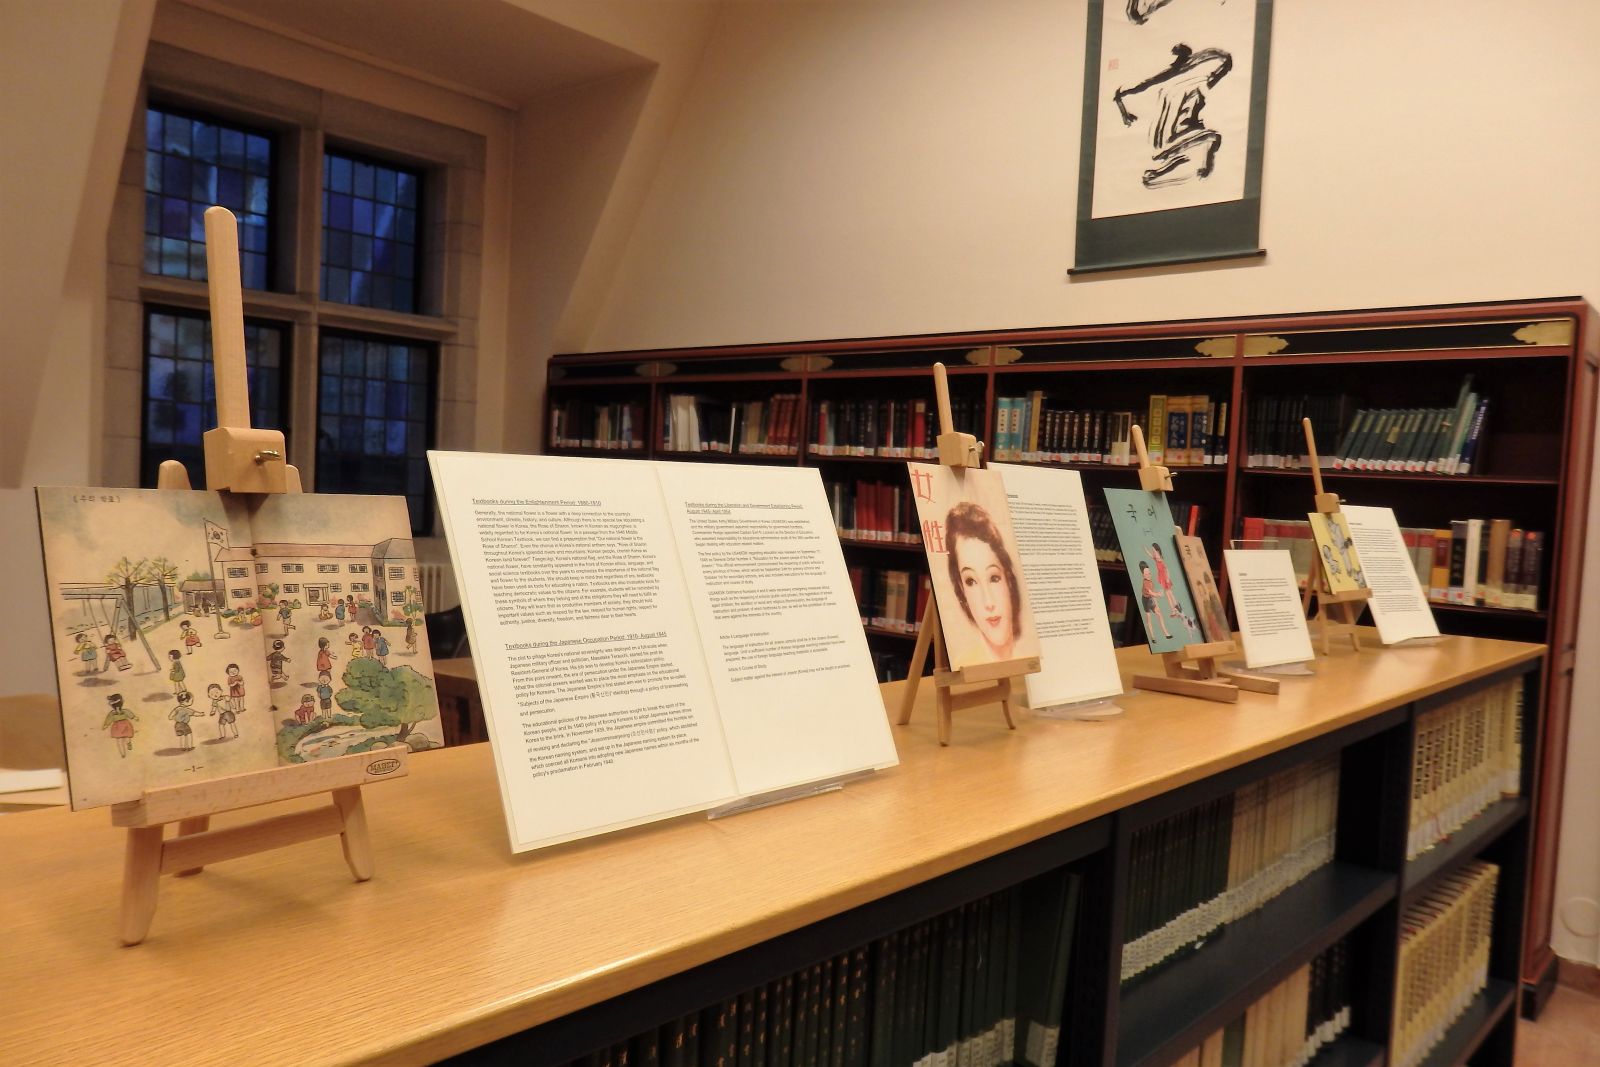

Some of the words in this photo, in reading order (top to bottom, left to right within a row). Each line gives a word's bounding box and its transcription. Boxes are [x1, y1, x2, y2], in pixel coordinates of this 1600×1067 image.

[504, 641, 532, 650] Textbooks
[531, 640, 549, 648] during
[558, 638, 582, 646] Japanese
[582, 635, 610, 644] Occupation
